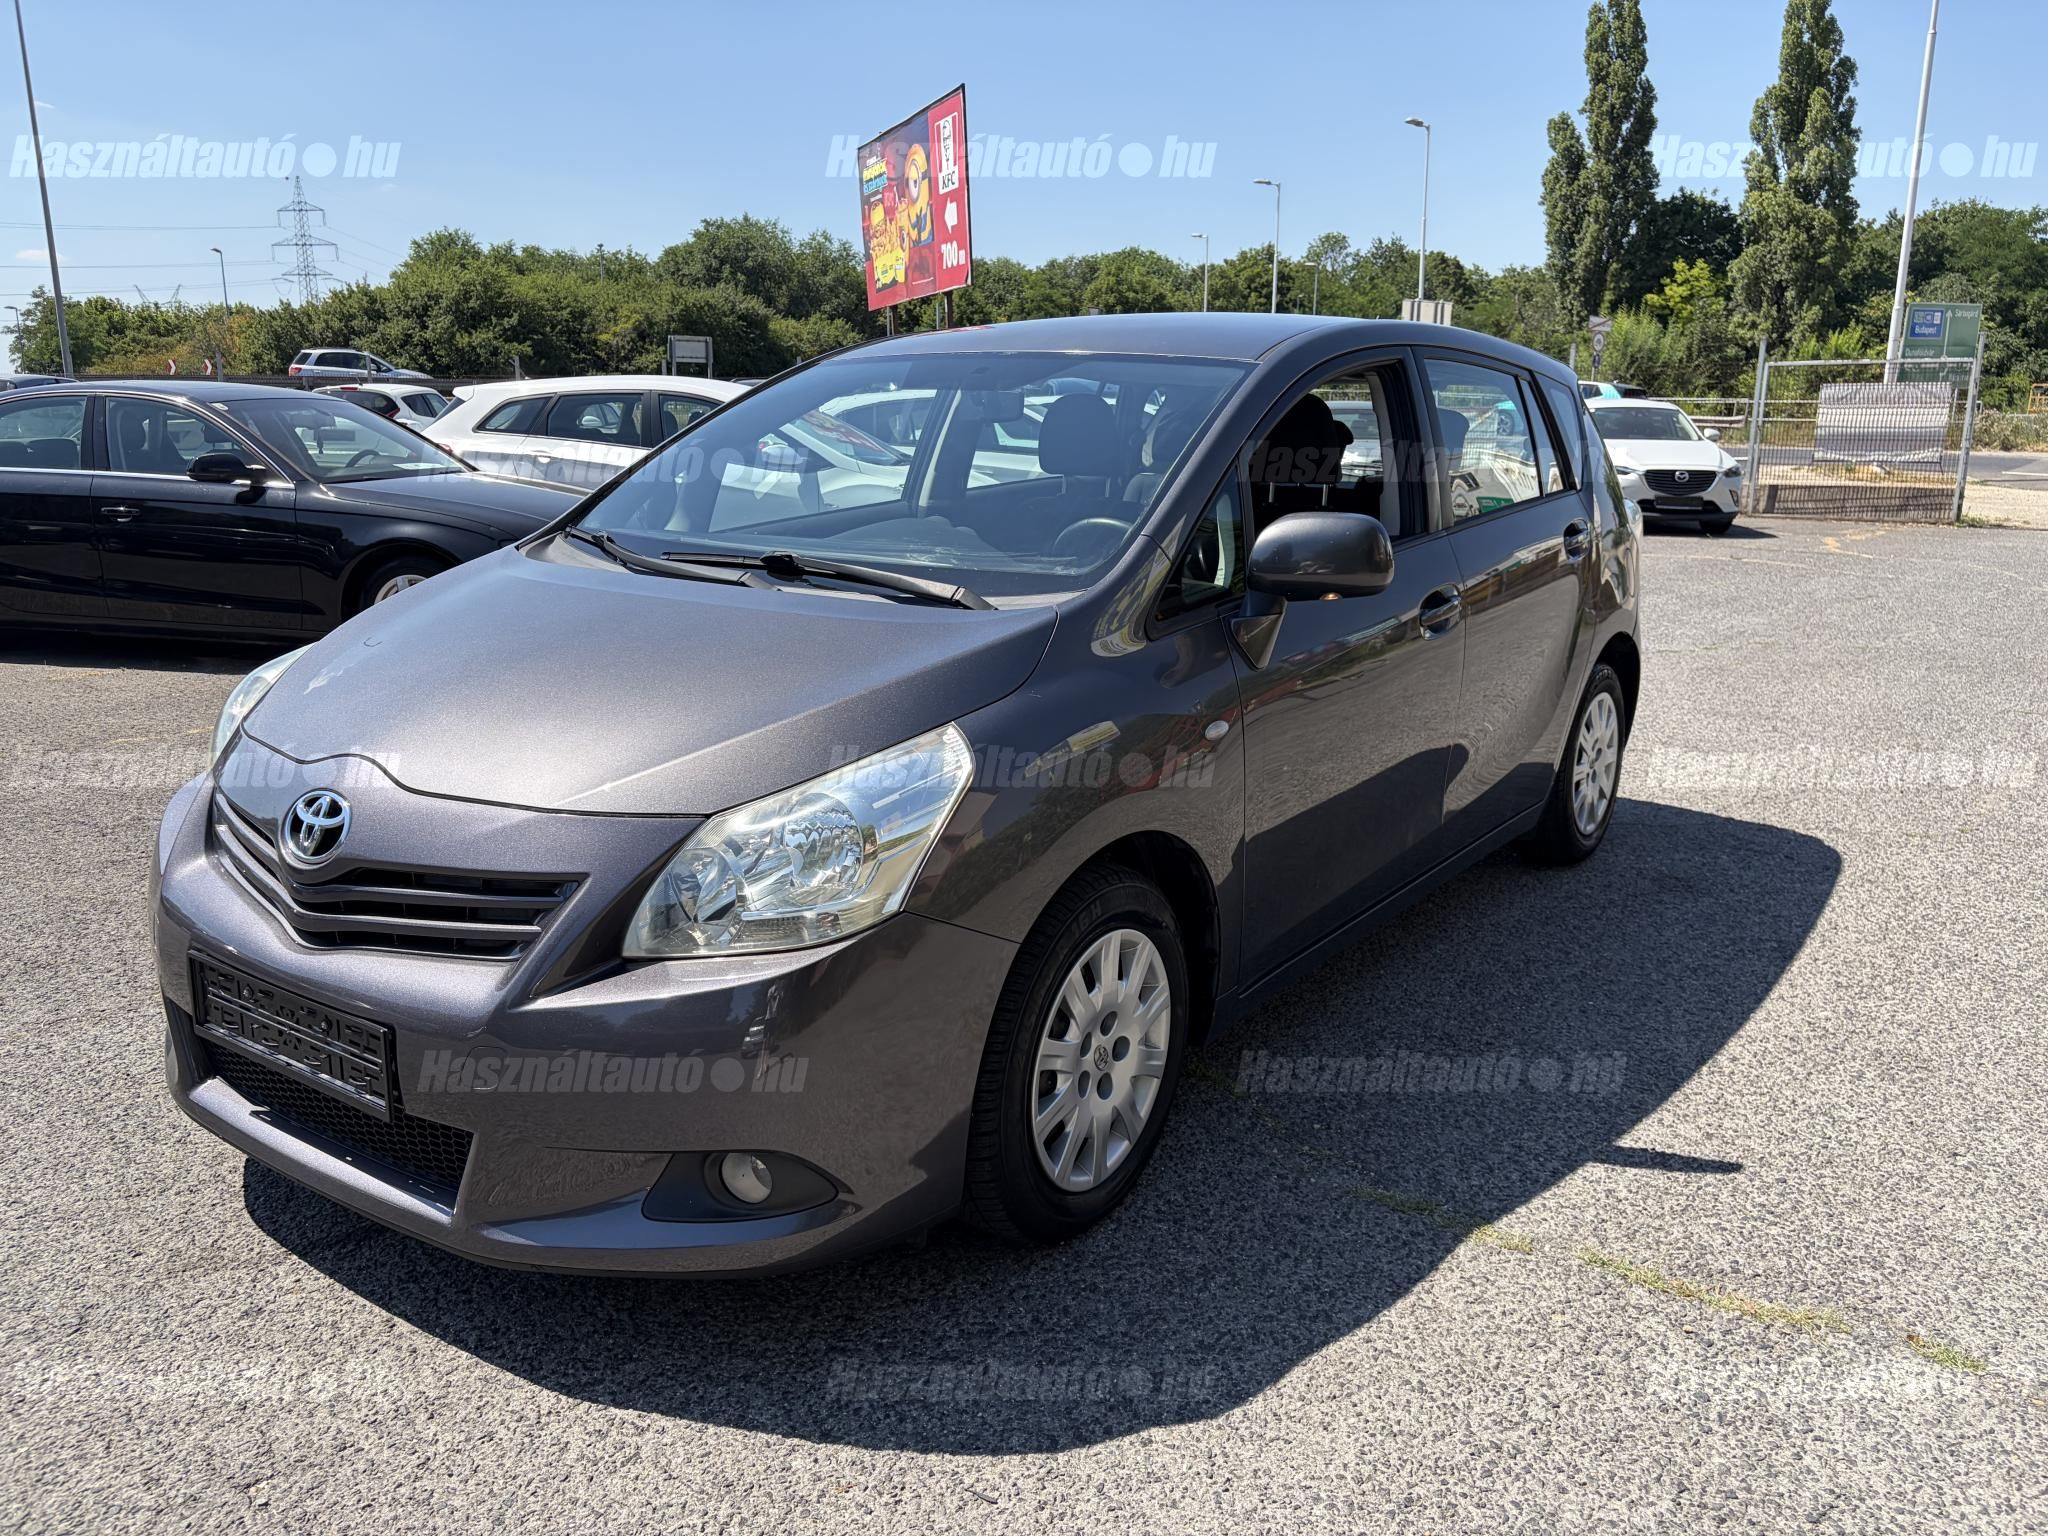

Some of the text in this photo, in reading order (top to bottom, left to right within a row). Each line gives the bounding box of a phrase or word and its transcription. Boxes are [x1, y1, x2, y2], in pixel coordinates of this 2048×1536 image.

[941, 171, 956, 191] KFC
[940, 240, 958, 270] 700
[1914, 325, 1937, 335] Budapest
